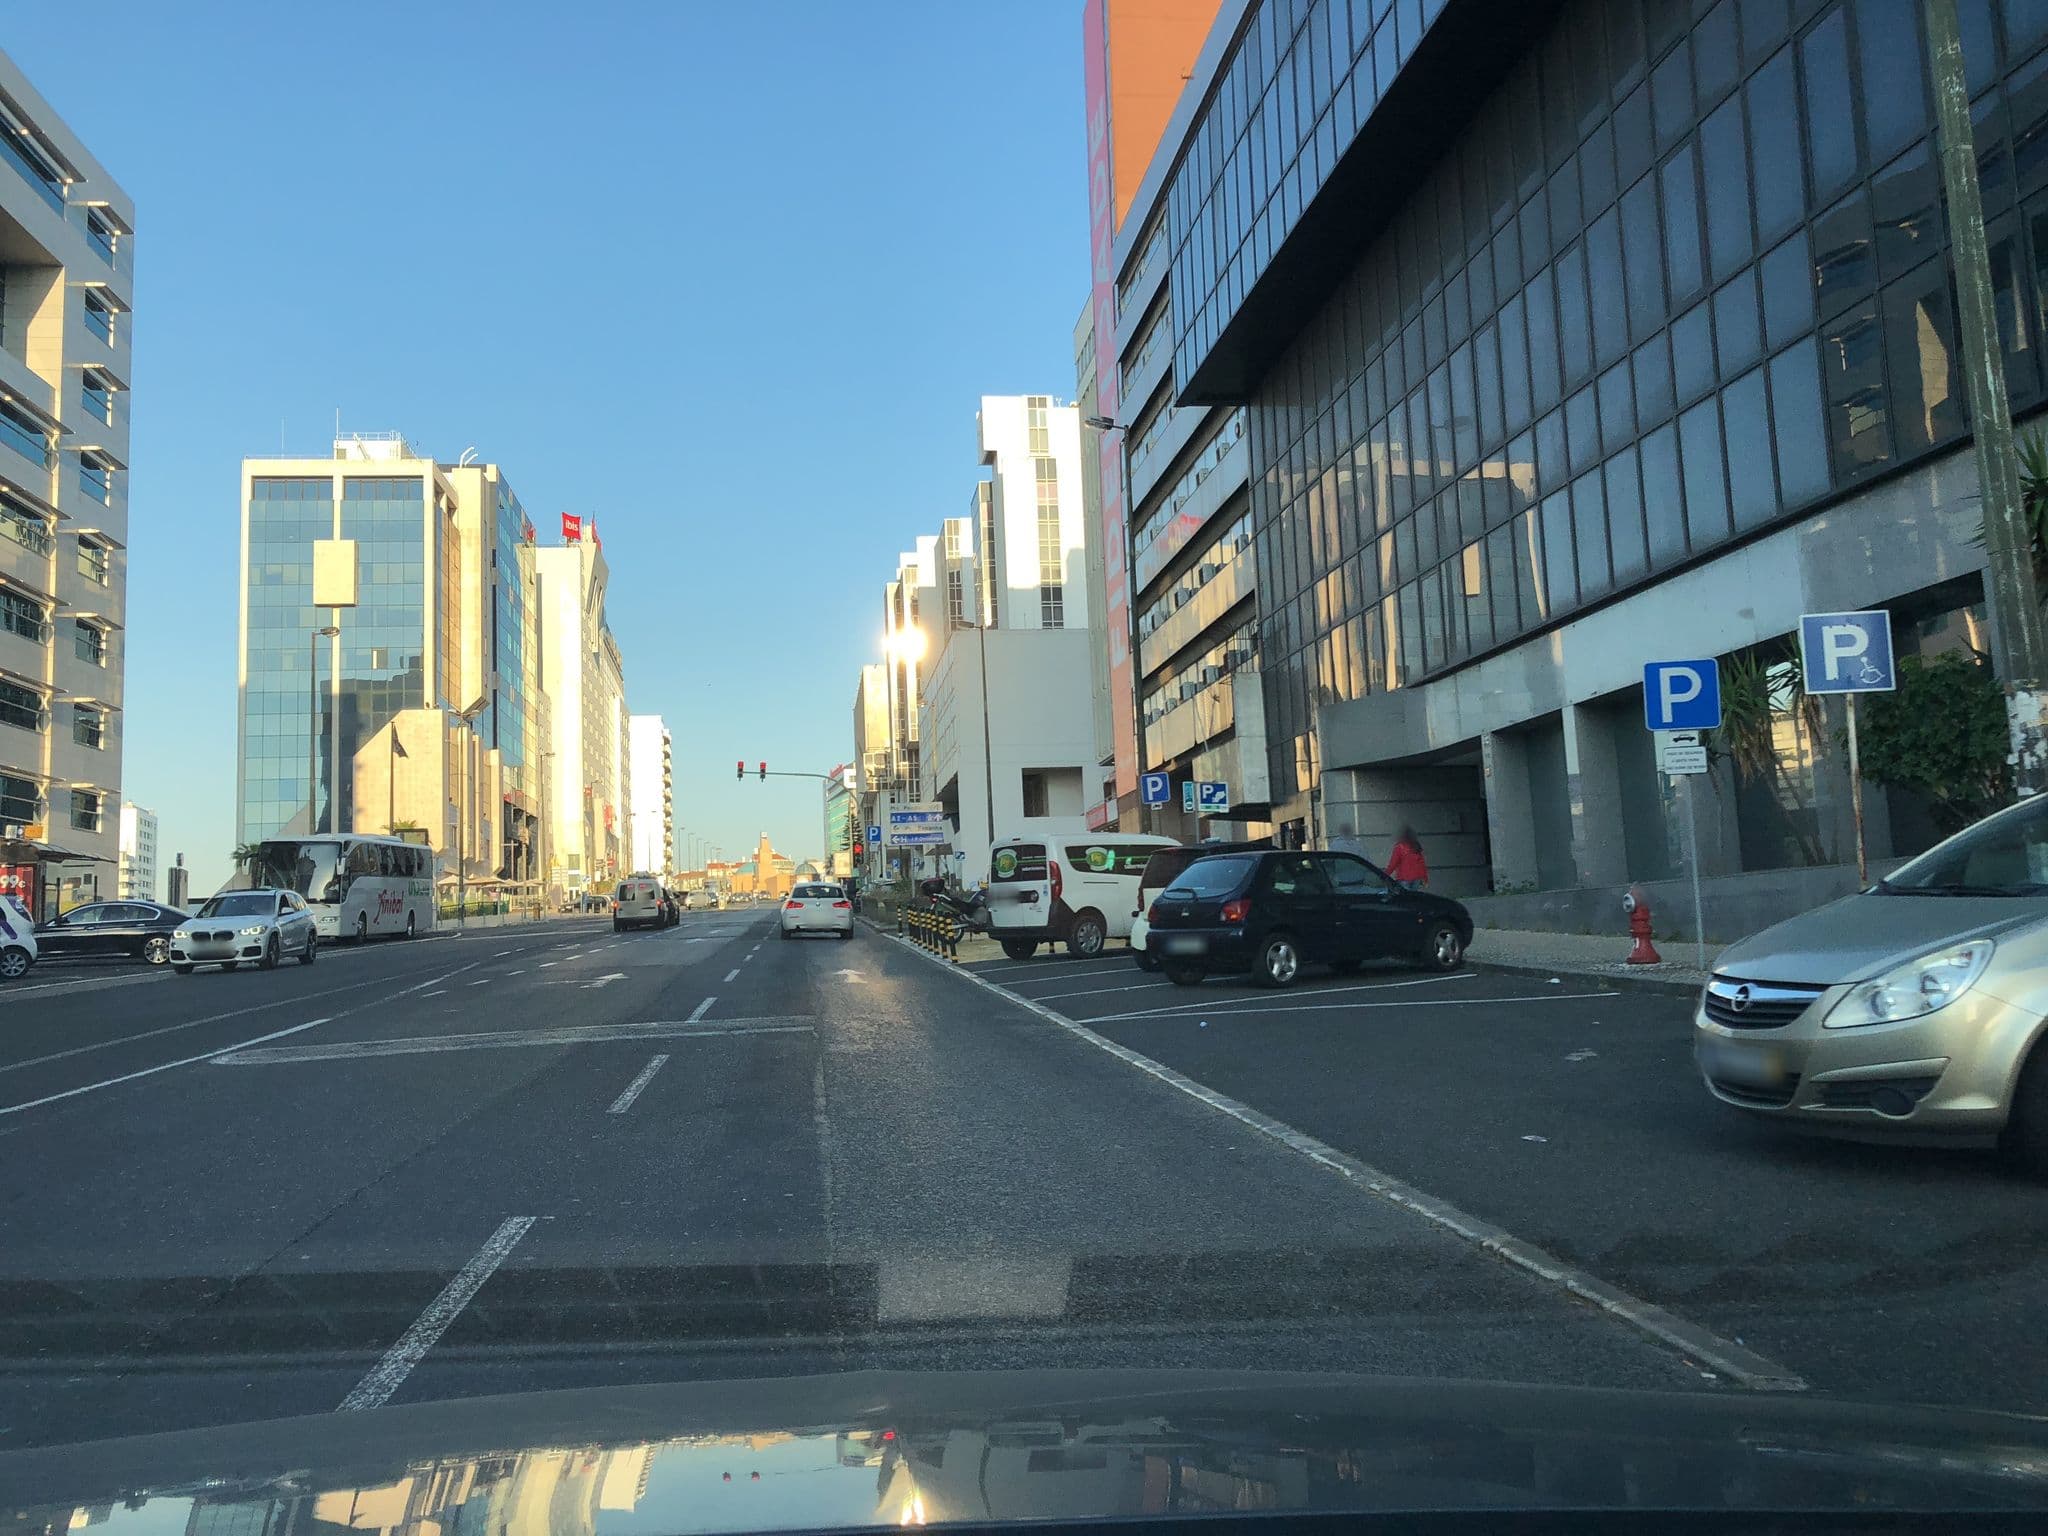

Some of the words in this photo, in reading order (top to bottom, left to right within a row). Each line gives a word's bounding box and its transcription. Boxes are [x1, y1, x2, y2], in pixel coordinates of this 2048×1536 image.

[565, 519, 579, 531] ibis
[1822, 624, 1869, 681] P
[1659, 667, 1702, 723] P
[1146, 777, 1163, 801] P
[1203, 785, 1214, 799] P
[869, 828, 878, 840] P
